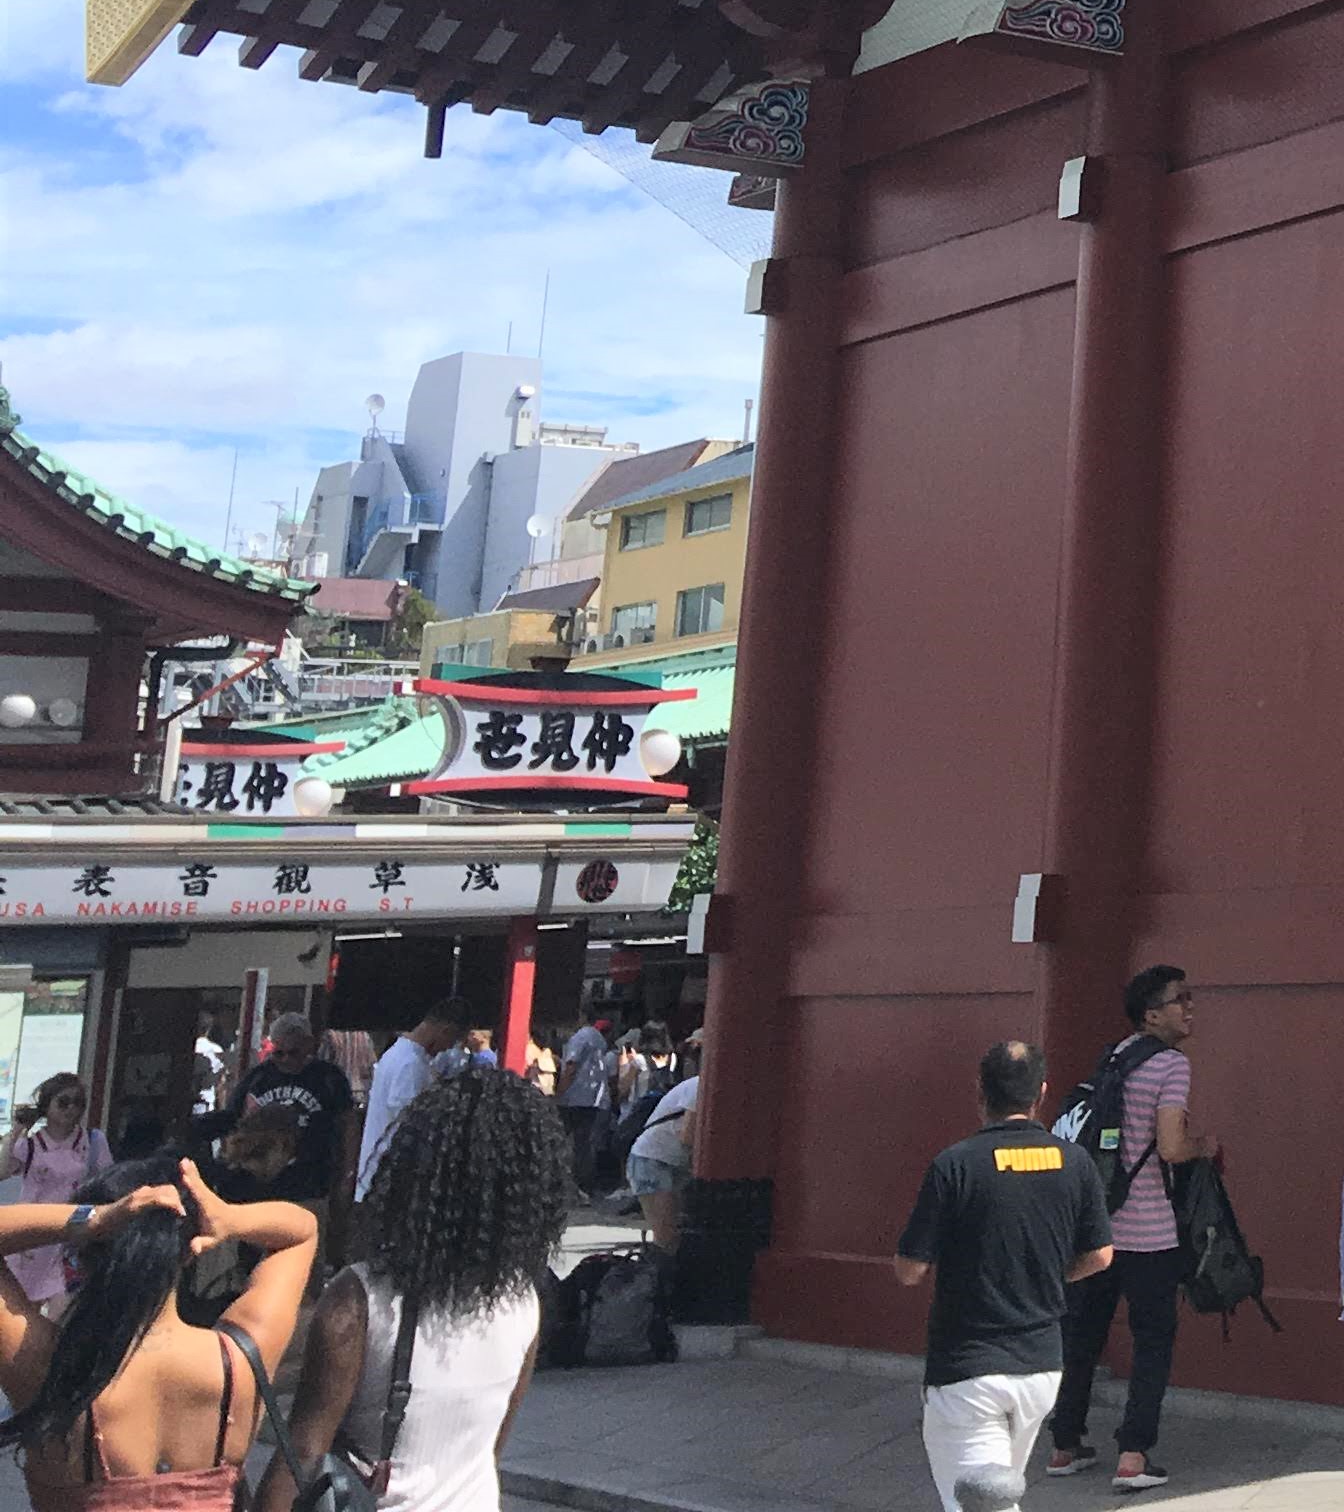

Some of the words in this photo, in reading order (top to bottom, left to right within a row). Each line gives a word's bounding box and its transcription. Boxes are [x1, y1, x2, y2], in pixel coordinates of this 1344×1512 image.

[180, 760, 289, 815] 仲見
[0, 861, 501, 898] 浅草観音表
[76, 899, 199, 917] NAKAMISE
[230, 897, 348, 916] SHOPPING
[993, 1146, 1063, 1172] PUMA
